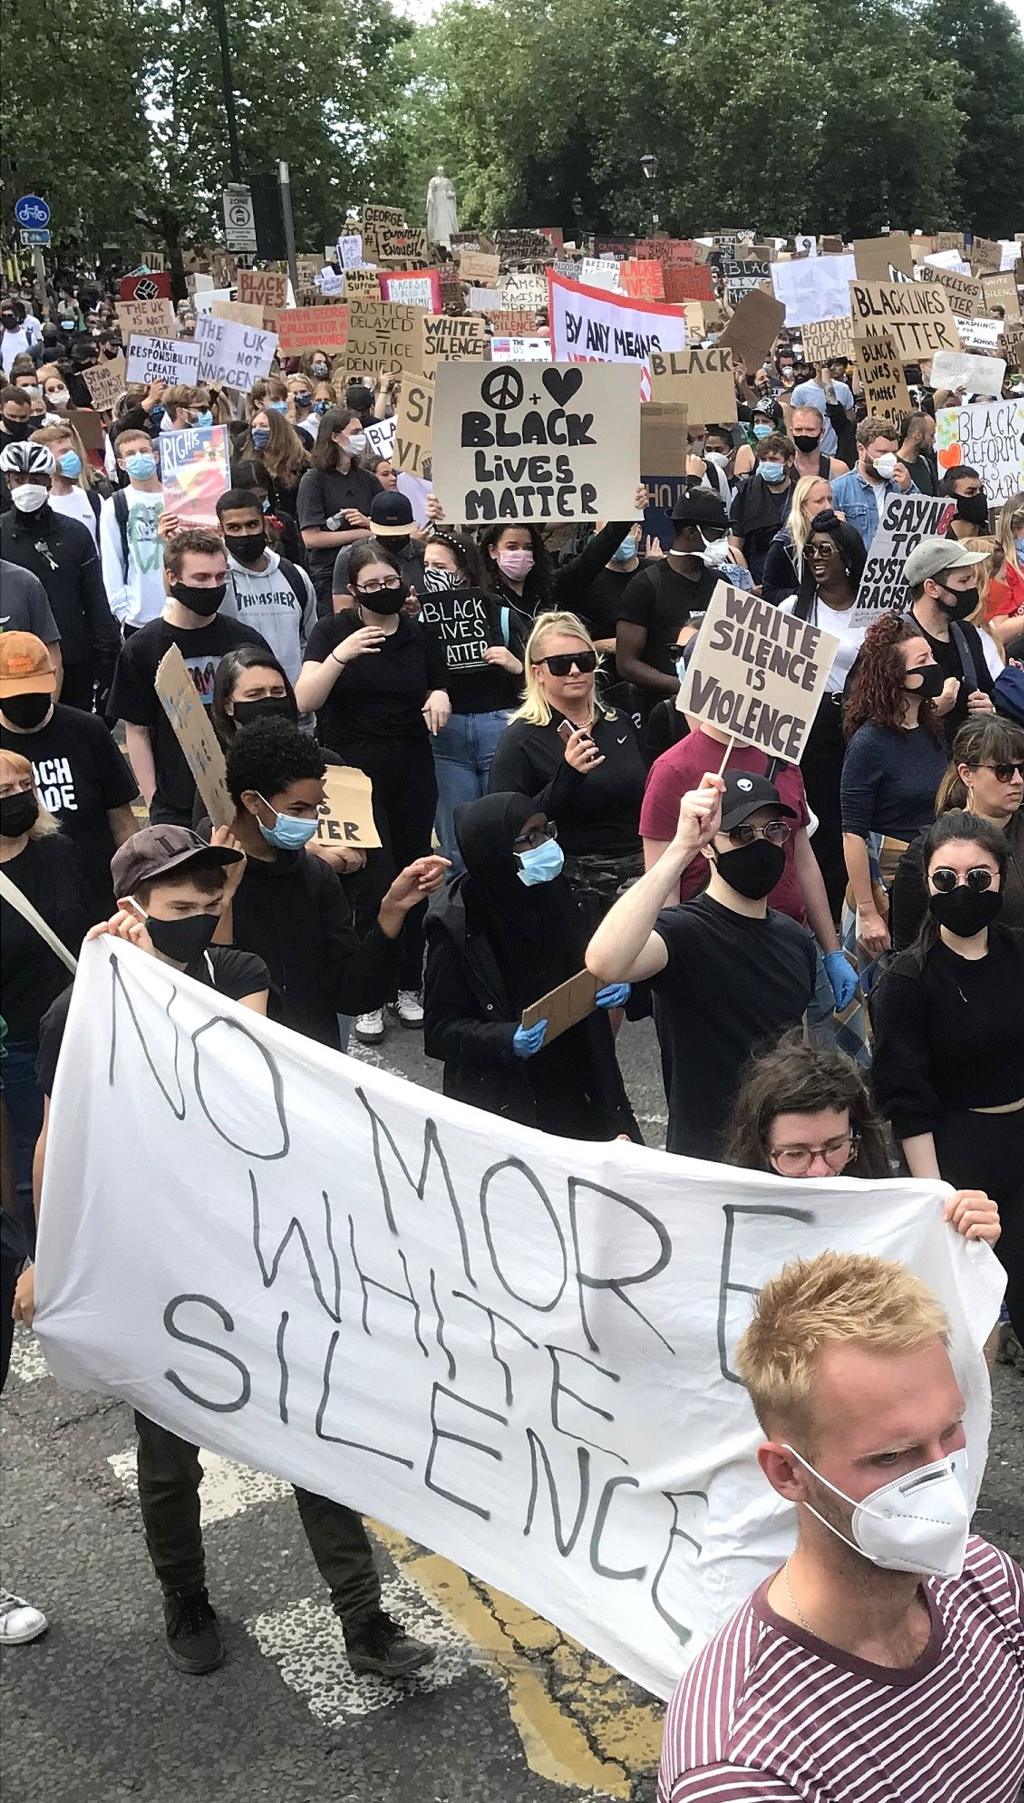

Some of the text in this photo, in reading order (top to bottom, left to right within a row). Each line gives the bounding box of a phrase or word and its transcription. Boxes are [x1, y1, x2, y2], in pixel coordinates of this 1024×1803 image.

[364, 208, 403, 227] GEORGE
[241, 274, 285, 293] BLACK
[924, 267, 980, 297] BLACK LIVES
[121, 302, 165, 314] THE UK
[241, 291, 286, 309] LIVES
[350, 300, 416, 320] JUSTICE
[856, 286, 946, 318] BLACK LIVES
[949, 295, 974, 313] TTER
[146, 317, 166, 326] NOT
[312, 307, 347, 320] GEORG
[351, 317, 414, 332] DELAYED
[490, 312, 533, 321] WHITE
[199, 318, 267, 352] THE UK
[423, 318, 480, 337] WHITE
[494, 321, 536, 331] SILENCE
[565, 310, 663, 359] BY ANY MEANS
[802, 317, 852, 336] BOTTOMS
[150, 338, 175, 352] TAKE
[347, 339, 415, 358] JUSTICE
[425, 336, 484, 356] SILENCE
[803, 333, 832, 347] TOPS
[861, 340, 897, 363] BLACK
[202, 342, 262, 367] IS NOT
[346, 357, 402, 375] DENIED
[651, 350, 732, 376] BLACK
[147, 362, 177, 376] CREATE
[198, 361, 257, 388] NNOCEN
[369, 422, 397, 445] BLA
[460, 408, 598, 448] BLACK
[957, 403, 1020, 443] BLACK
[961, 435, 1019, 466] REFORM
[464, 483, 599, 521] MATTER
[883, 499, 957, 536] SAY NO
[423, 597, 487, 623] BLACK
[438, 619, 485, 640] IVES
[726, 587, 822, 660] WHITE
[709, 619, 818, 692] SILENCE
[745, 668, 766, 692] IS
[689, 669, 807, 760] VIOLENCE
[317, 818, 362, 842] TER
[108, 955, 291, 1161] NO
[356, 1086, 816, 1385] MORE
[249, 1168, 632, 1467] WHITE
[162, 1291, 710, 1644] SILENCE
